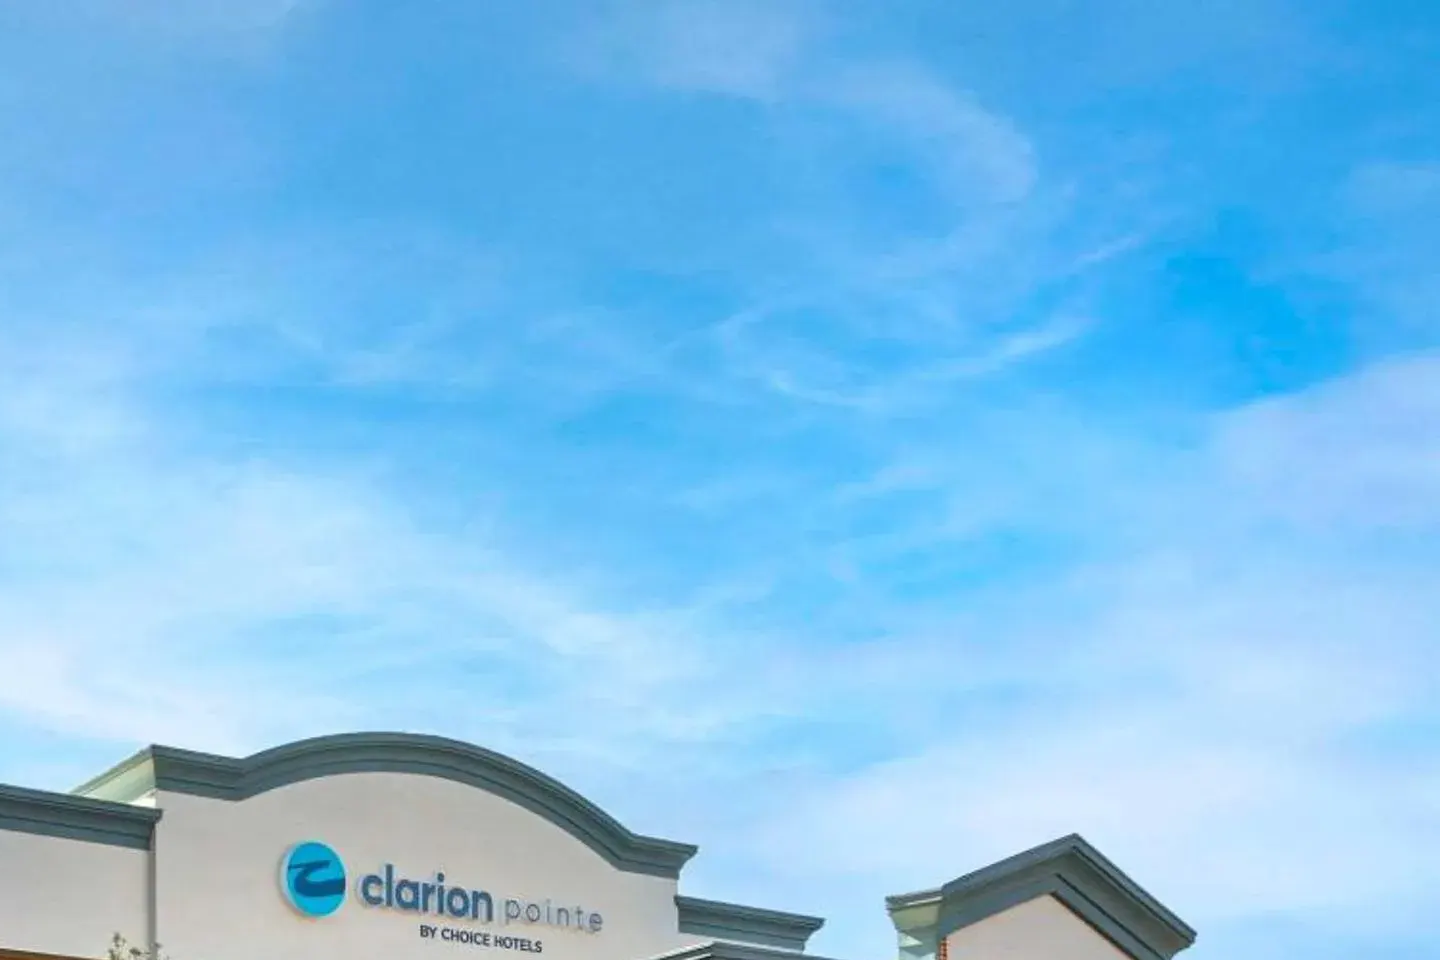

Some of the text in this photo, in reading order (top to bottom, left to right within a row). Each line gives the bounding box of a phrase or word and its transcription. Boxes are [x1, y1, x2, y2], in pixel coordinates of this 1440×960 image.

[361, 863, 604, 933] clarion pointe
[420, 924, 543, 953] BY CHOICE HOTELS
